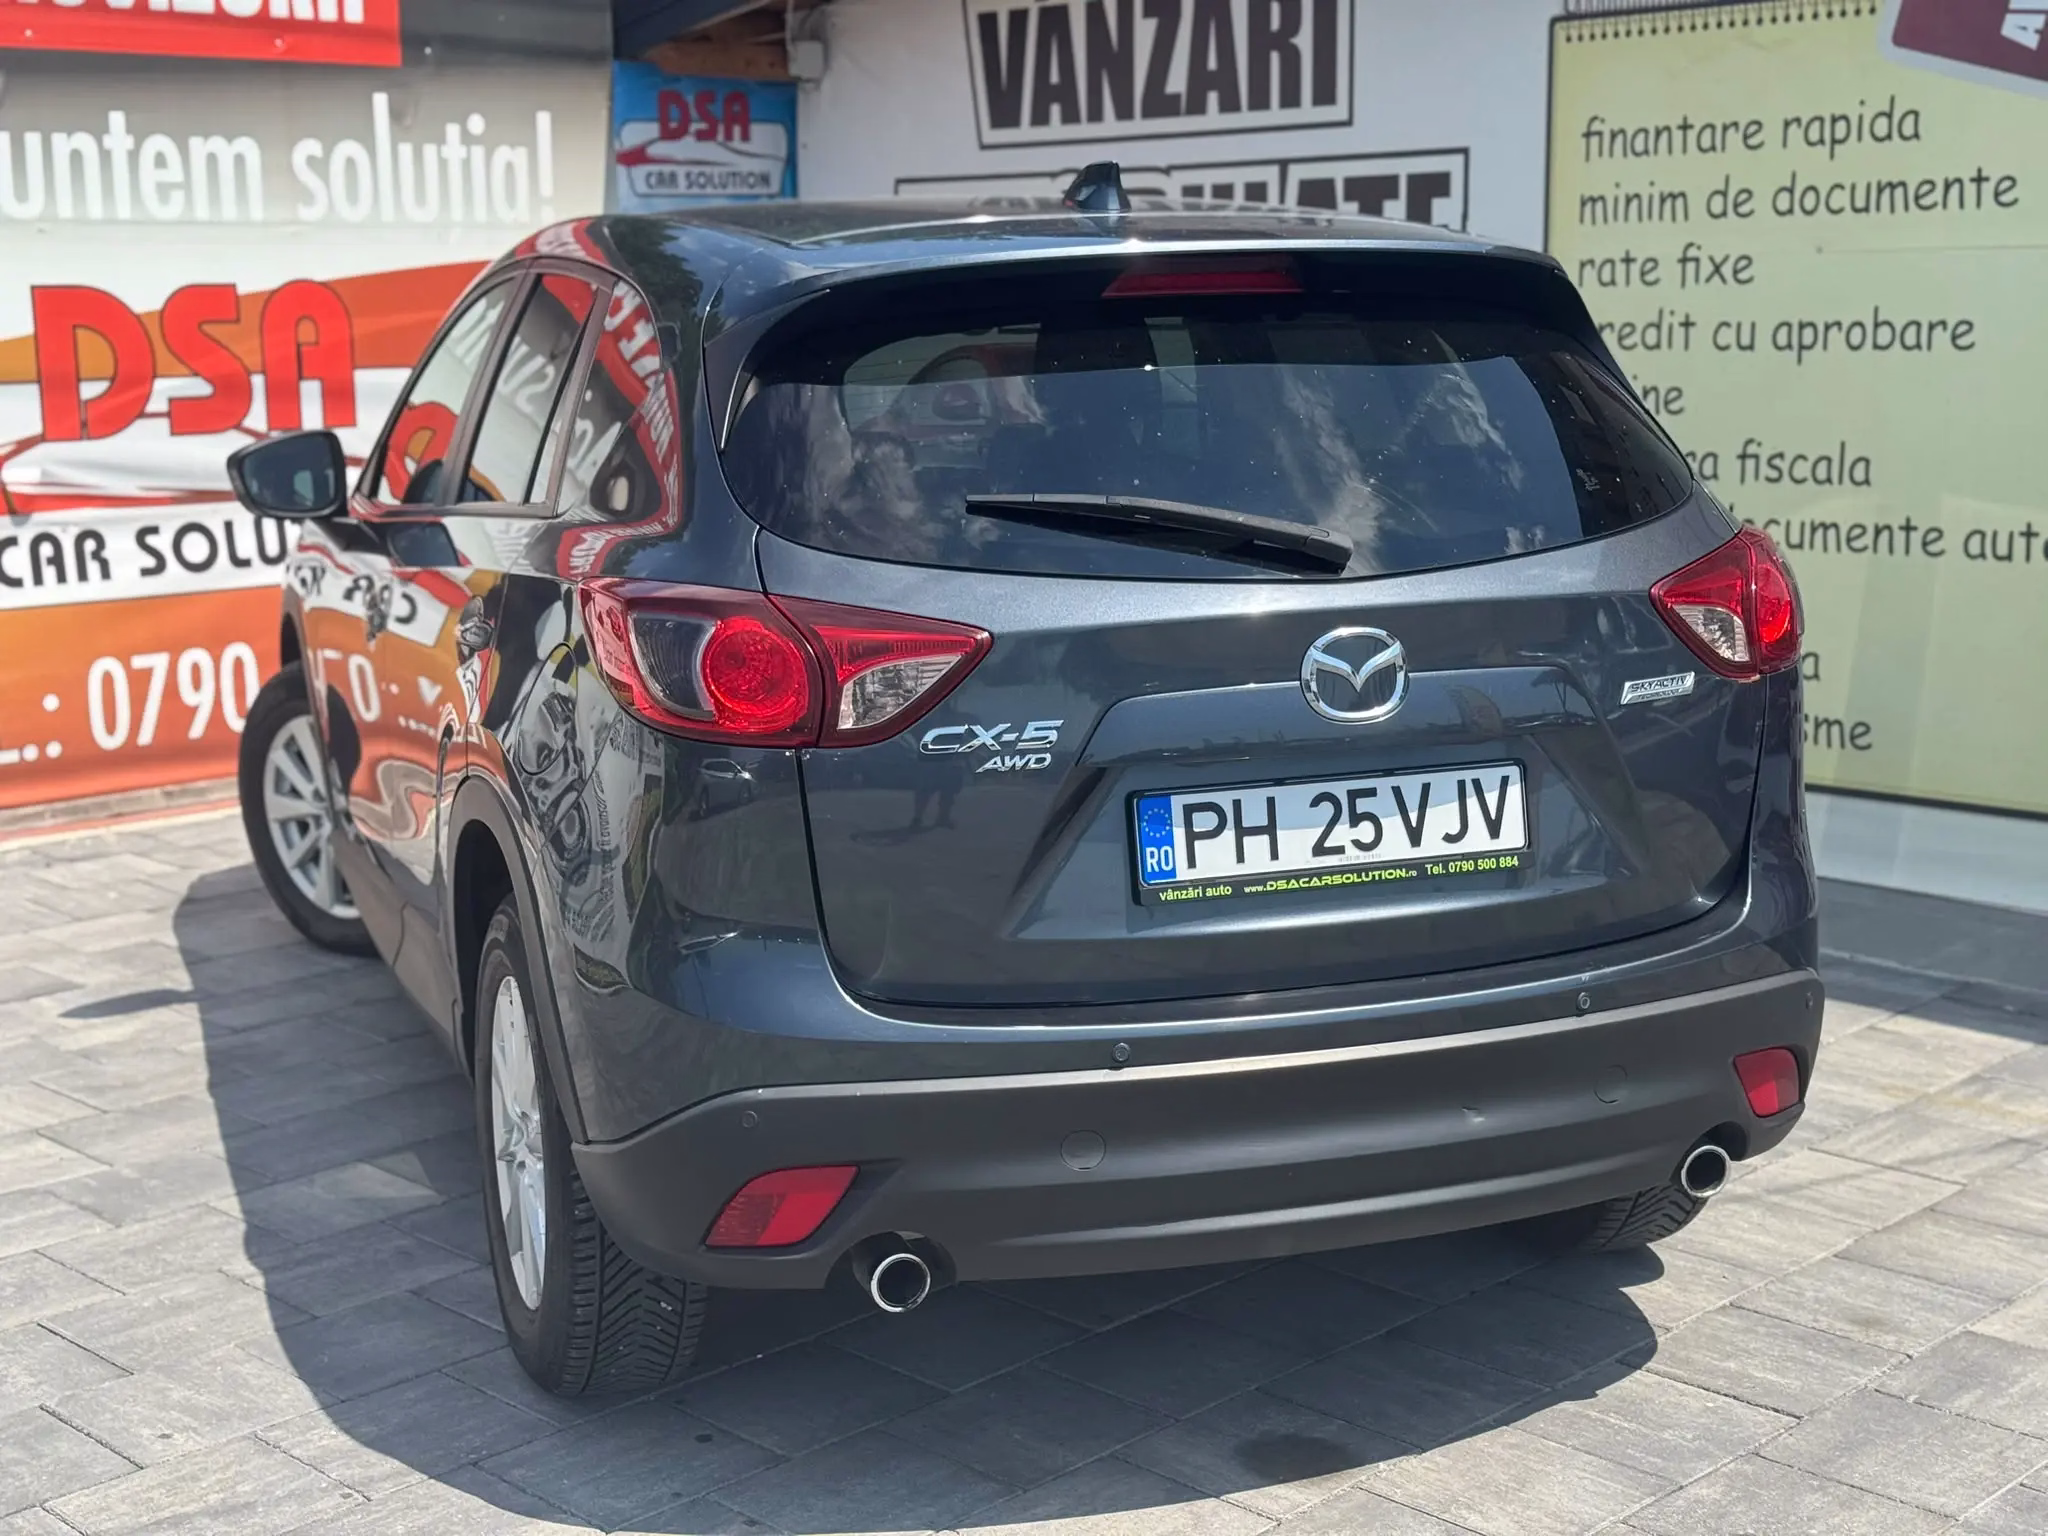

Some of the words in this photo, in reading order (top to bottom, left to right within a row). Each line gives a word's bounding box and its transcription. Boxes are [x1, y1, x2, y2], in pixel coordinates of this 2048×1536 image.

[658, 89, 751, 142] DSA
[1581, 115, 1766, 162] finantare
[1782, 95, 1921, 160] rapida
[0, 111, 261, 220] untem
[291, 92, 554, 224] solutia!
[645, 170, 678, 190] CAR
[685, 170, 770, 190] SOLUTION
[1579, 181, 1690, 226] minim
[1706, 174, 1755, 220] de
[1772, 166, 2020, 217] documente
[1578, 249, 1661, 288] rate
[1677, 242, 1755, 289] fixe
[30, 279, 357, 441] DSA
[1598, 307, 1697, 352] redit
[1712, 320, 1755, 352] cu
[1772, 305, 1976, 366] aprobare
[1736, 438, 1873, 488] fiscala
[135, 515, 287, 577] SOLU
[87, 640, 261, 751] 0790
[1631, 675, 1690, 693] SKYACTIV
[920, 719, 1065, 754] CX-5
[975, 752, 1052, 773] AWD
[1145, 846, 1174, 873] RO
[1181, 796, 1279, 870] PH
[1205, 884, 1233, 898] auto
[1424, 863, 1447, 876] Tel.
[1449, 859, 1475, 873] 0790
[1477, 857, 1497, 870] 500
[1499, 855, 1519, 868] 884
